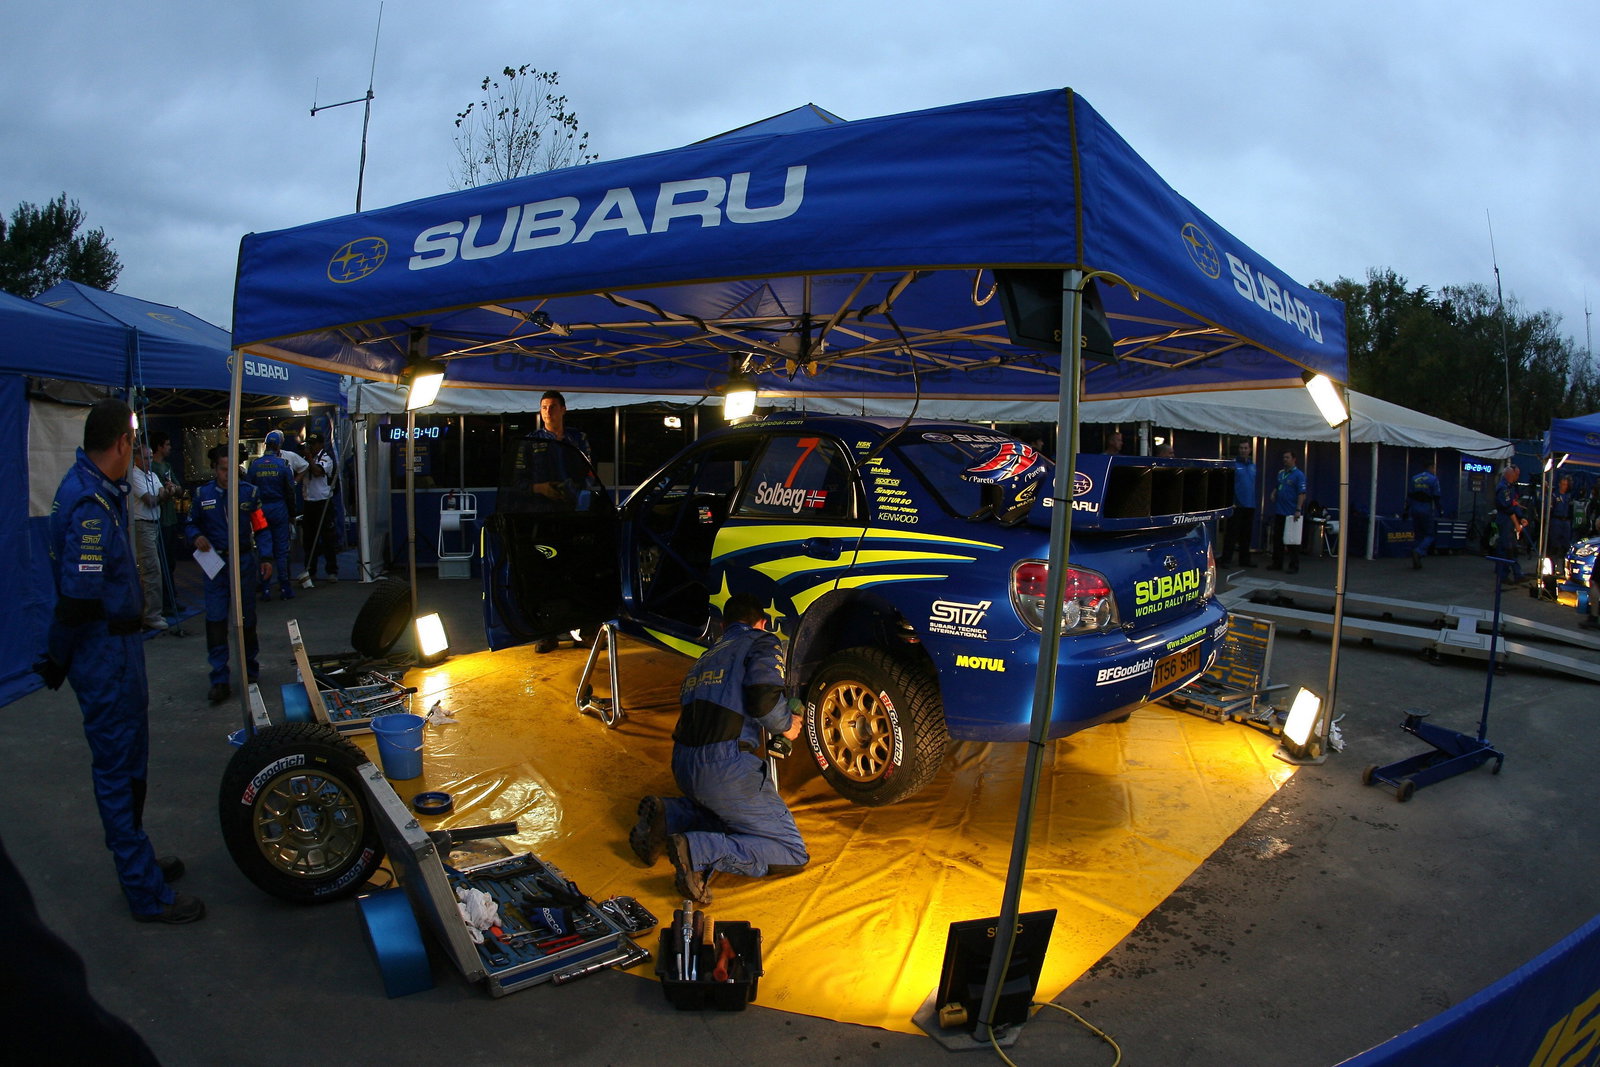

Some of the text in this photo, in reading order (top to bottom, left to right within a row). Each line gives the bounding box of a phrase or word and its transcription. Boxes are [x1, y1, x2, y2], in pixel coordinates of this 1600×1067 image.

[408, 165, 807, 271] SUBARU
[1225, 252, 1323, 344] SUBARU
[245, 360, 289, 380] SUBARU
[784, 438, 821, 488] 7
[973, 476, 995, 484] Pareto
[755, 481, 807, 513] Solberg
[888, 497, 912, 505] TURBO
[1042, 497, 1099, 513] SARU
[878, 513, 918, 524] KENWOOD
[1172, 515, 1212, 525] STI Performance
[1135, 568, 1200, 605] SUBARU
[1135, 590, 1200, 618] WORLD RALLY TEAM
[929, 622, 988, 634] SUBARU TECNICA
[929, 627, 988, 640] INTERNATIONAL
[956, 654, 1006, 672] MOTUL
[1097, 657, 1153, 682] BFGoodrich
[1180, 649, 1198, 672] SRT
[808, 702, 829, 769] BFGoodrich
[880, 692, 903, 766] BFGoodrich
[242, 754, 304, 805] BFGoodrich
